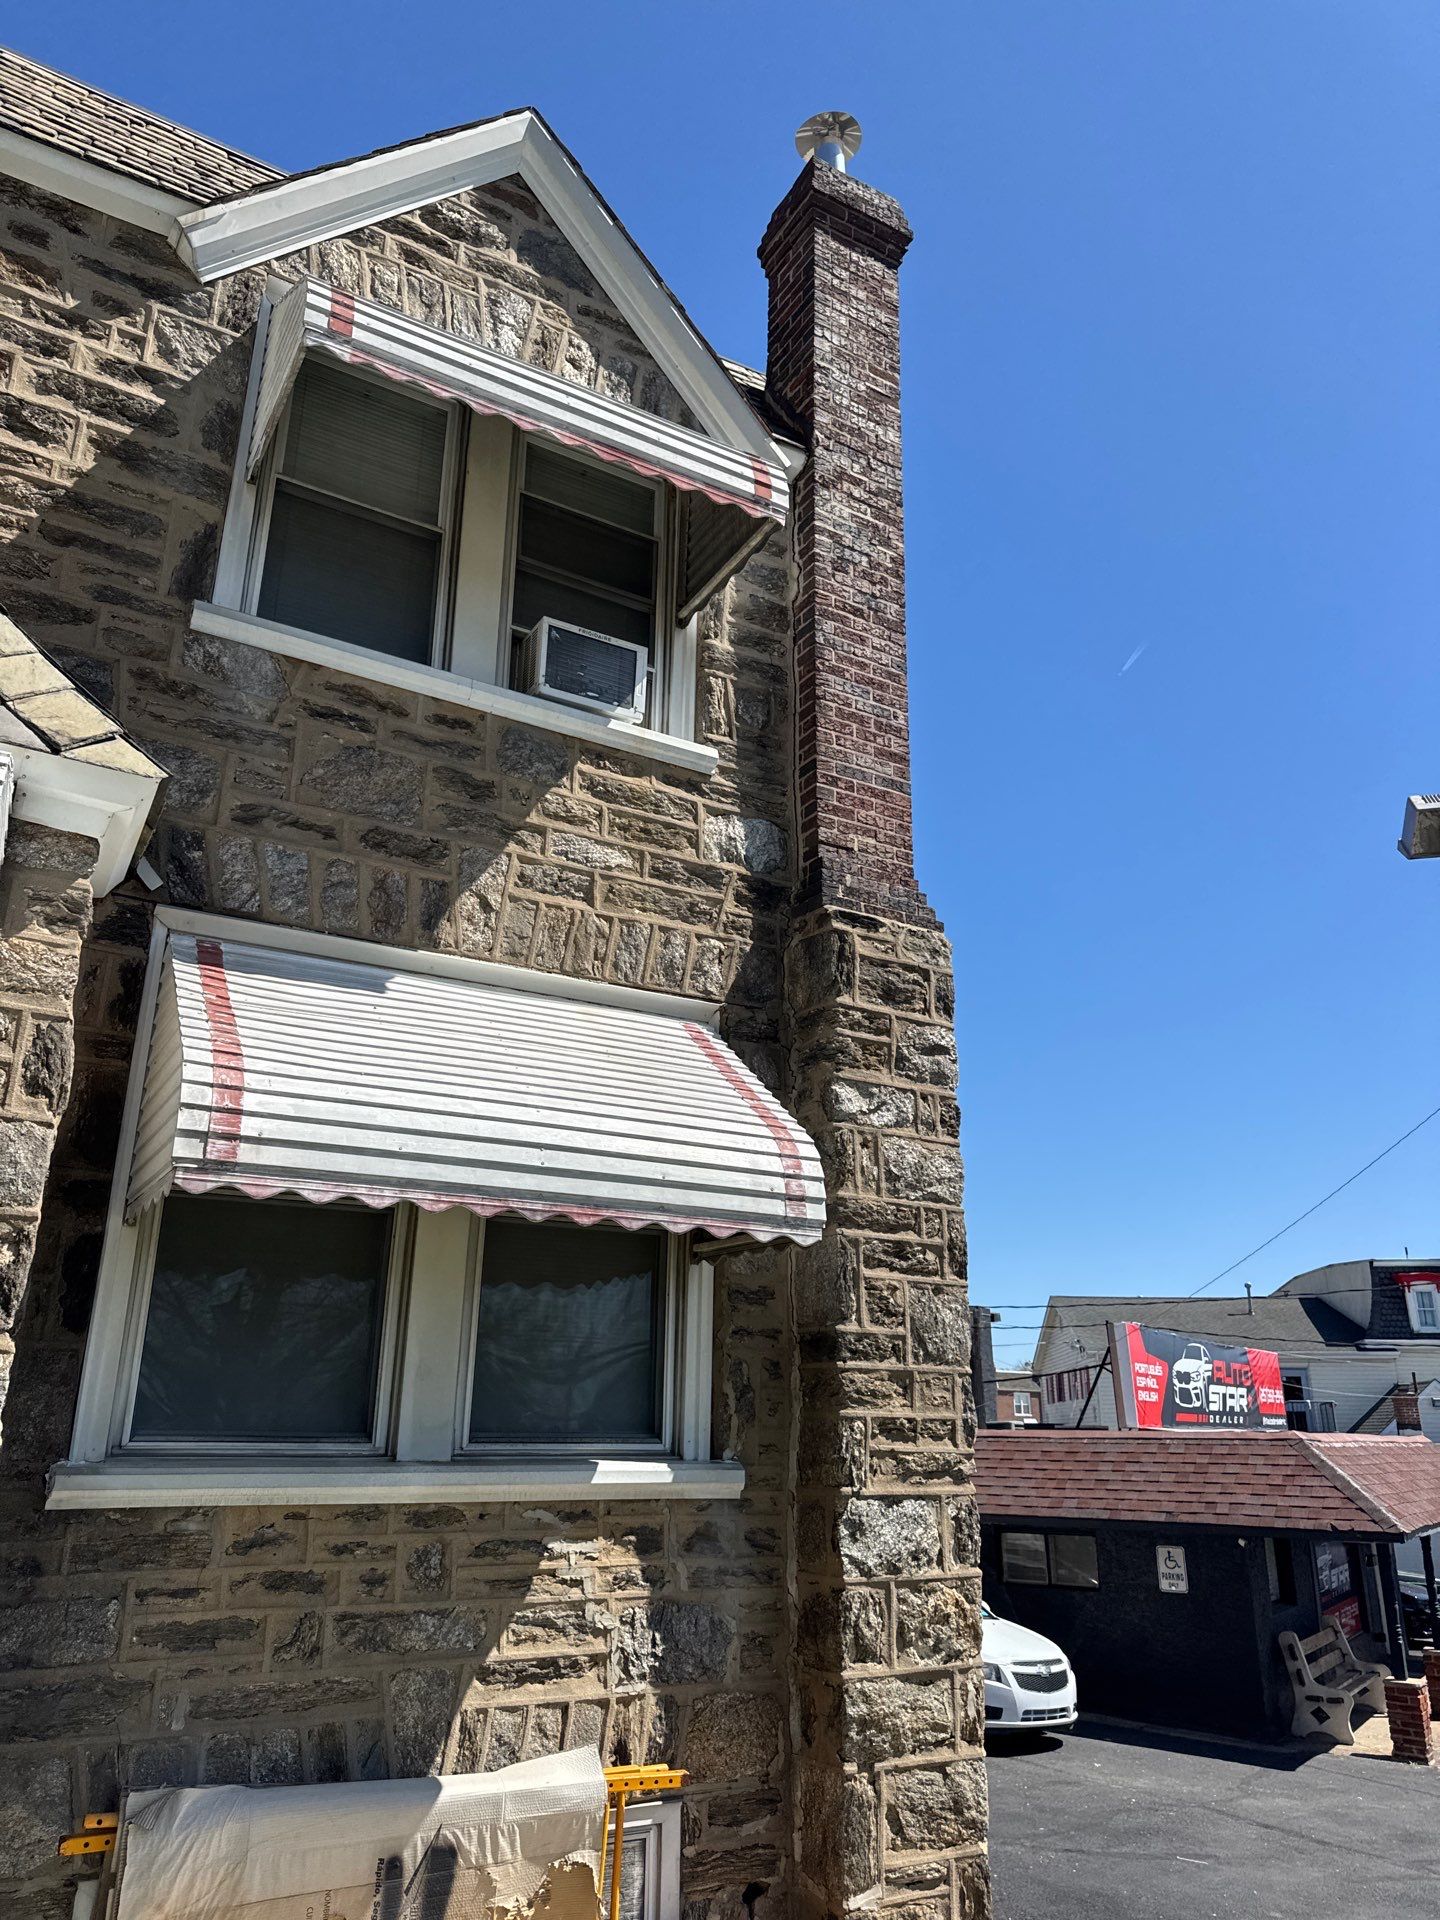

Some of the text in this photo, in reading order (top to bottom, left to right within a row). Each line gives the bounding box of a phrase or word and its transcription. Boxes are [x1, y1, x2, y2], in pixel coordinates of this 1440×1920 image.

[578, 628, 612, 642] FRIGIDAIRE
[1213, 1360, 1253, 1386] AUTO
[1136, 1375, 1159, 1389] ESPAÑOL
[1138, 1390, 1159, 1402] ENGLISH
[1208, 1384, 1248, 1413] STAR
[1209, 1415, 1244, 1424] DEALER
[1161, 1572, 1185, 1582] PARKING
[373, 1857, 385, 1898] Rápido,
